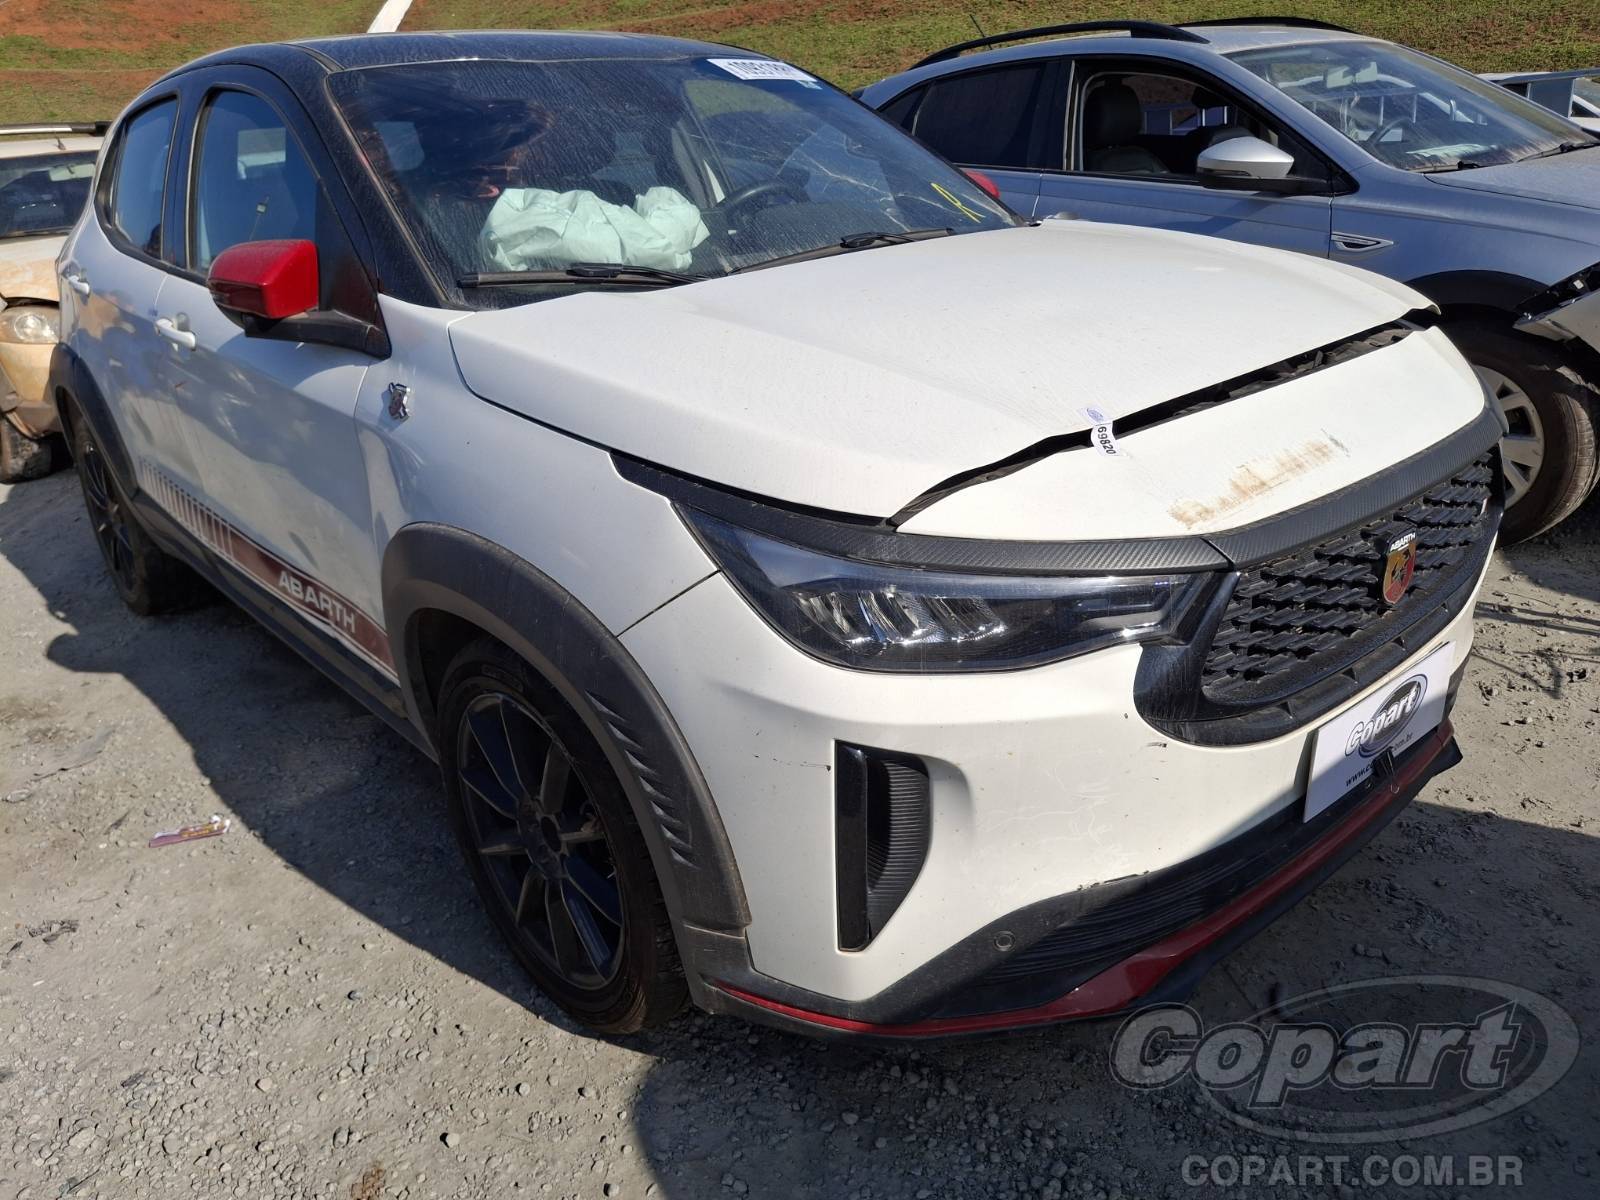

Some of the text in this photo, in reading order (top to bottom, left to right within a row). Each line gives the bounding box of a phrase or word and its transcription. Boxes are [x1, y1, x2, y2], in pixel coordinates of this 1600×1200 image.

[1097, 426, 1117, 455] 69820
[1390, 532, 1416, 551] ABARTH
[278, 570, 356, 633] ABARTH
[1346, 681, 1421, 756] Copart
